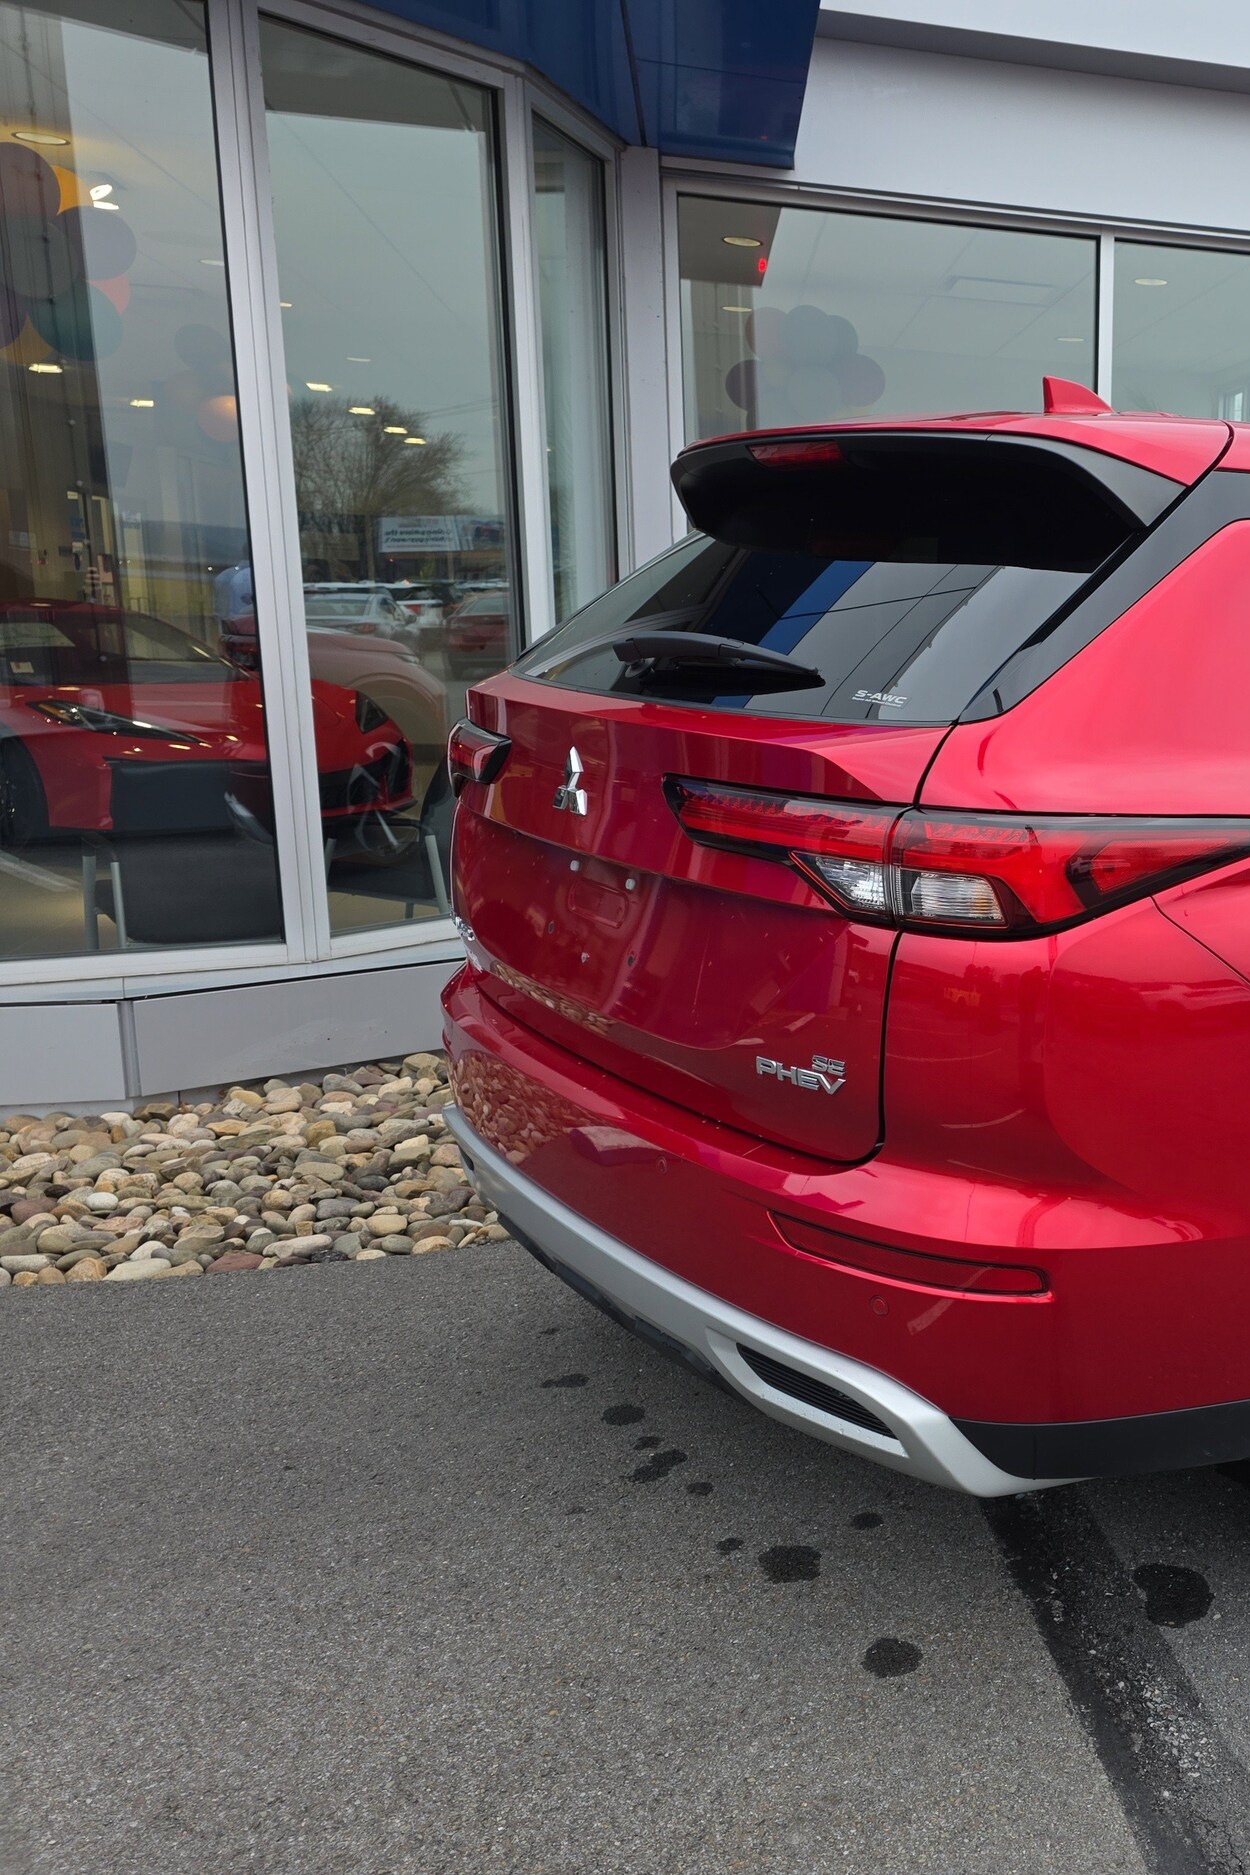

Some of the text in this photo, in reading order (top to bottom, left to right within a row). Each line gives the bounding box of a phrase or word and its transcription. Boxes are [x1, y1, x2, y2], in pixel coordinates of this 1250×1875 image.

[855, 690, 907, 704] S-AWC
[756, 1056, 846, 1095] PHEV
[812, 1055, 845, 1076] SE
